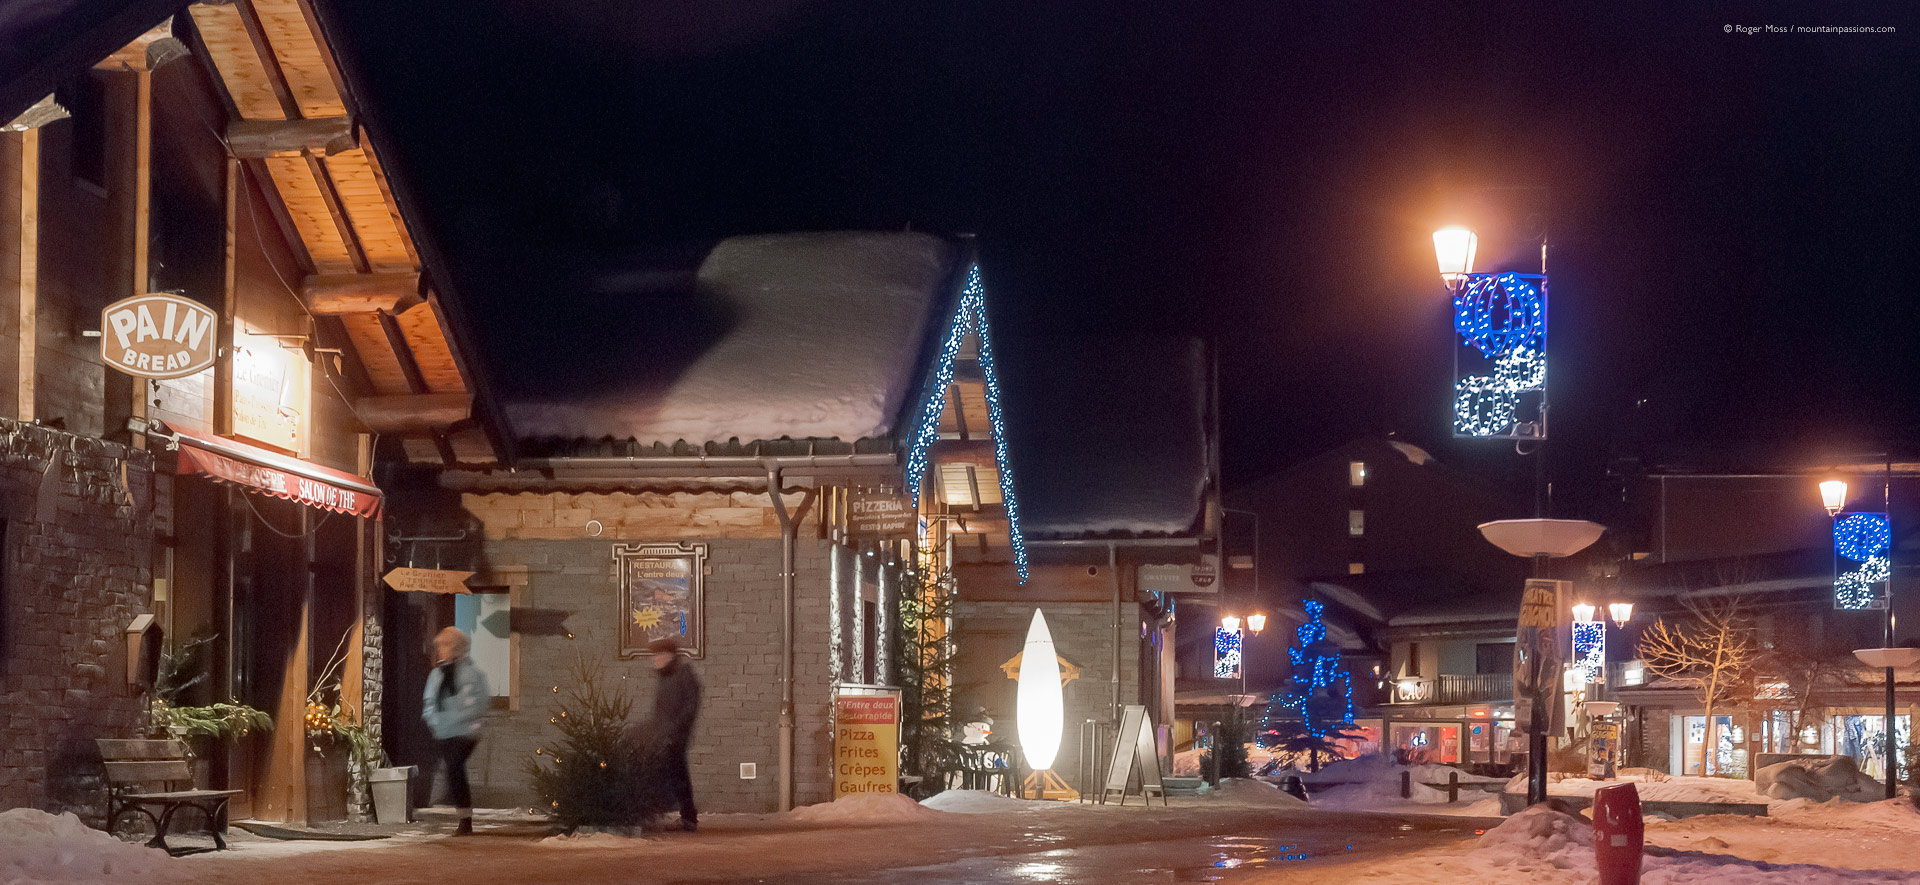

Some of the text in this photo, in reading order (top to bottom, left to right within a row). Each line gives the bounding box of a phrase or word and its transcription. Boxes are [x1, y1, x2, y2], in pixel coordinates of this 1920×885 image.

[109, 302, 211, 352] PAIN
[122, 348, 191, 371] BREAD
[298, 479, 325, 504] SALON
[338, 490, 355, 511] THE
[872, 701, 894, 709] deux
[865, 712, 893, 721] rapide
[840, 729, 875, 740] Pizza
[840, 746, 879, 758] Frites
[840, 763, 886, 777] Crêpes
[840, 781, 892, 793] Gaufres
